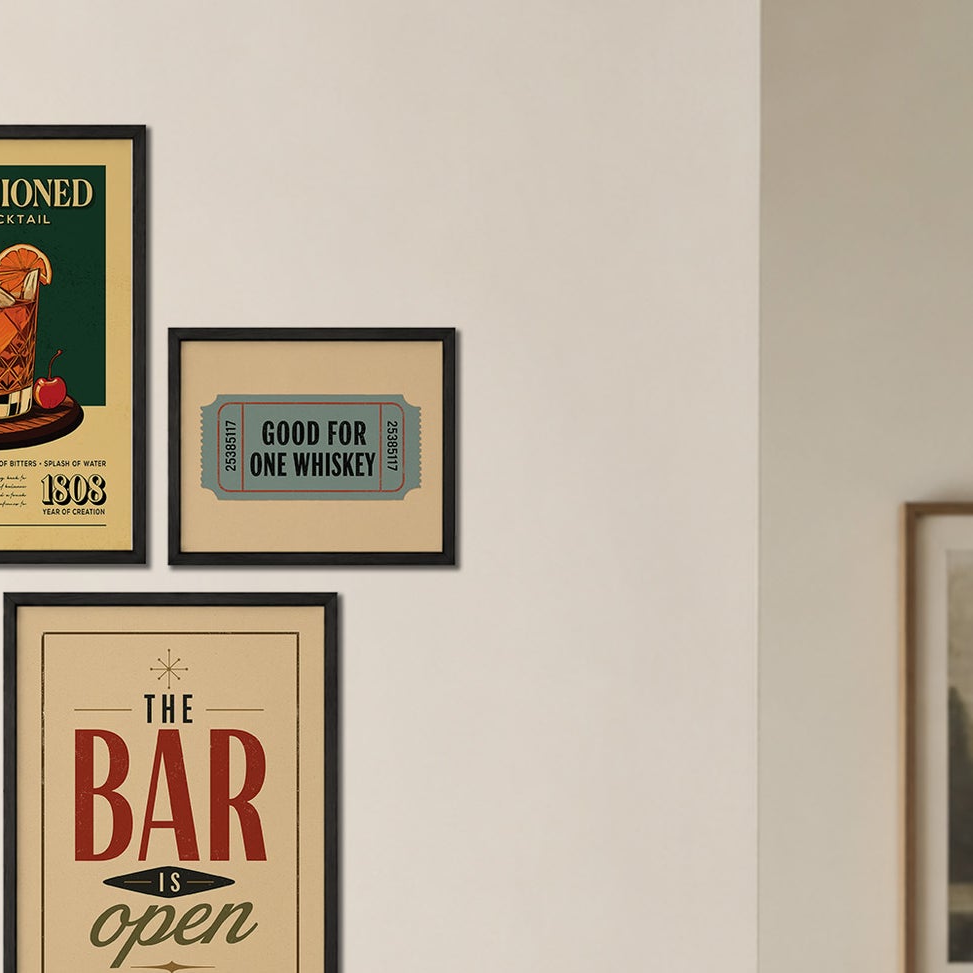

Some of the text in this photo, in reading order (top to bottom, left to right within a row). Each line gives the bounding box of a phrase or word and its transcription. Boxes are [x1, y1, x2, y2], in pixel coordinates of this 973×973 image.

[224, 420, 237, 472] 25385117
[261, 420, 367, 446] GOOD FOR
[386, 420, 399, 472] 25385117
[9, 459, 38, 468] BITTERS
[43, 459, 70, 468] SPLASH
[71, 460, 81, 468] OF
[82, 459, 107, 468] WATER
[249, 451, 376, 477] ONE WHISKEY
[40, 473, 107, 506] 1808
[42, 508, 106, 516] YEAR OF CREATION
[143, 693, 193, 724] THE
[74, 728, 268, 862] BAR
[159, 871, 182, 893] IS
[89, 901, 259, 969] open
